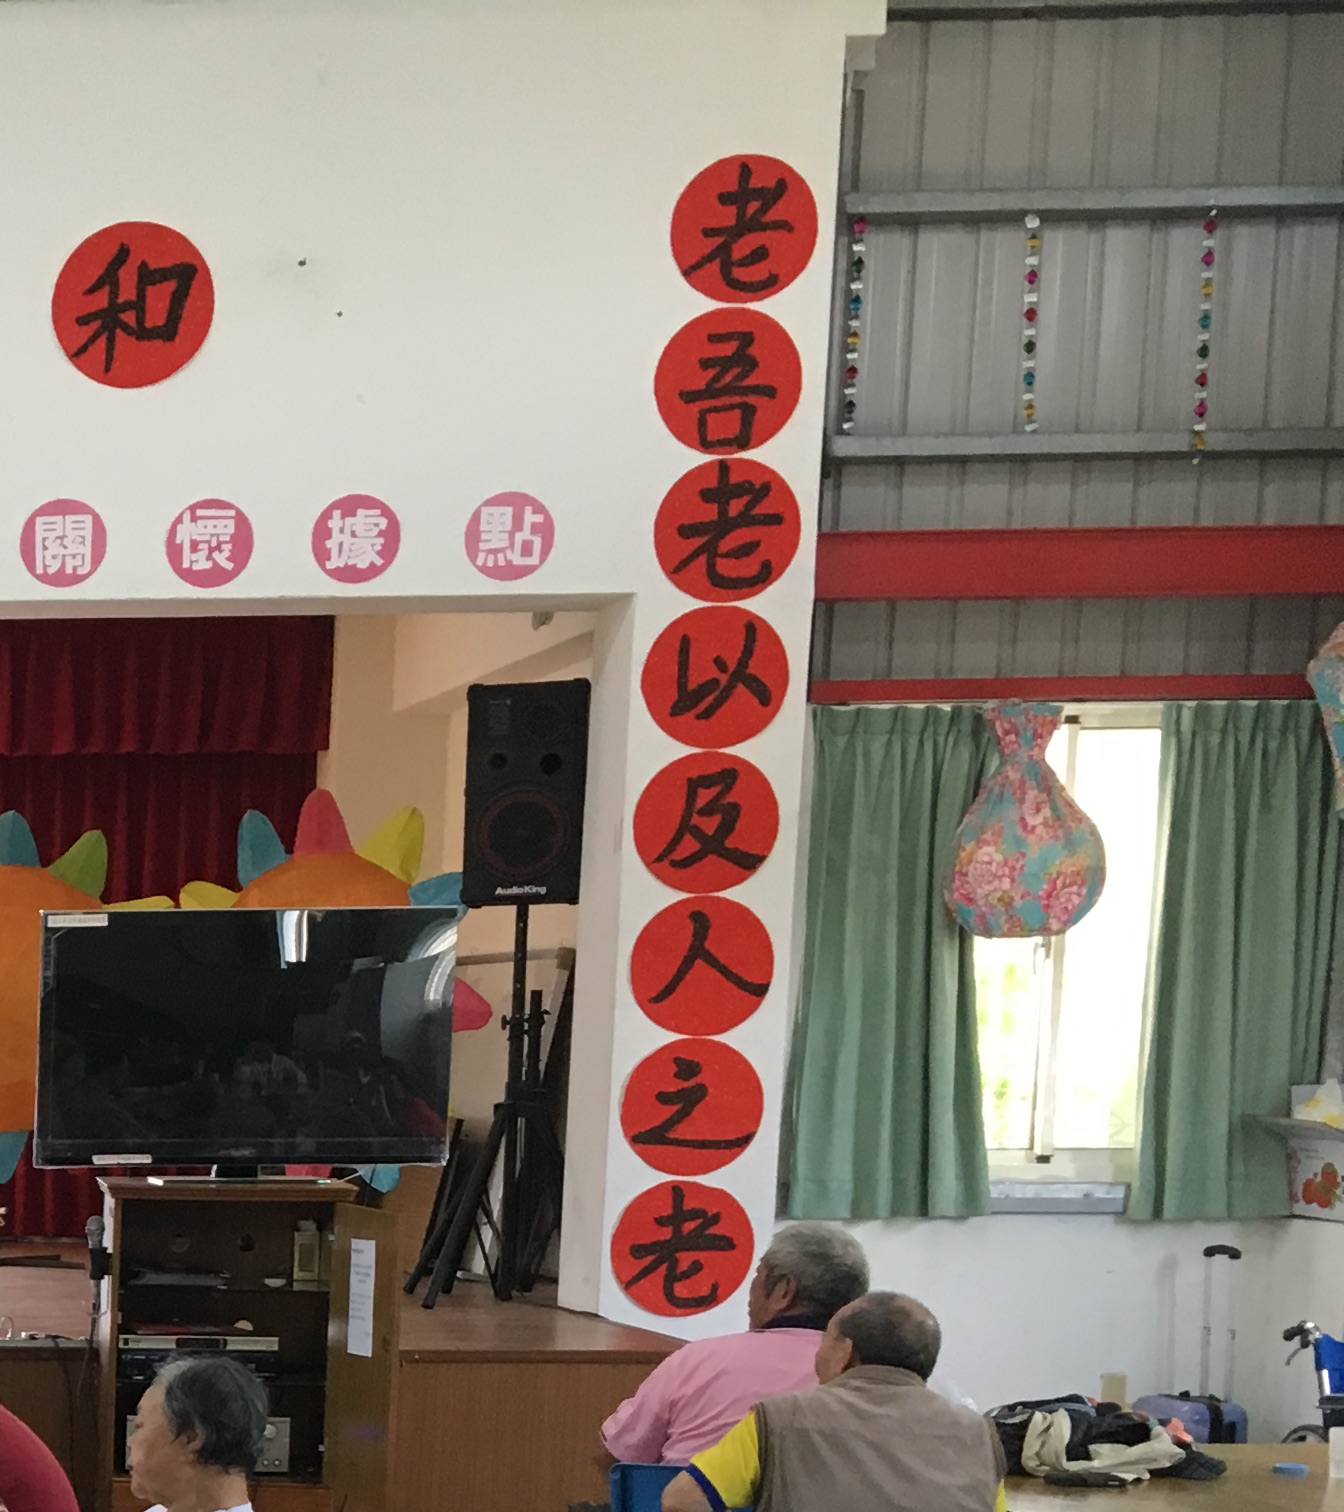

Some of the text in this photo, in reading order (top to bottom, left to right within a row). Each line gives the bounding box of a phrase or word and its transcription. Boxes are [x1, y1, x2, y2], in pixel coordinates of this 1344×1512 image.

[494, 885, 547, 896] AudioKing
[625, 162, 794, 1307] 老吾老以及人之老
